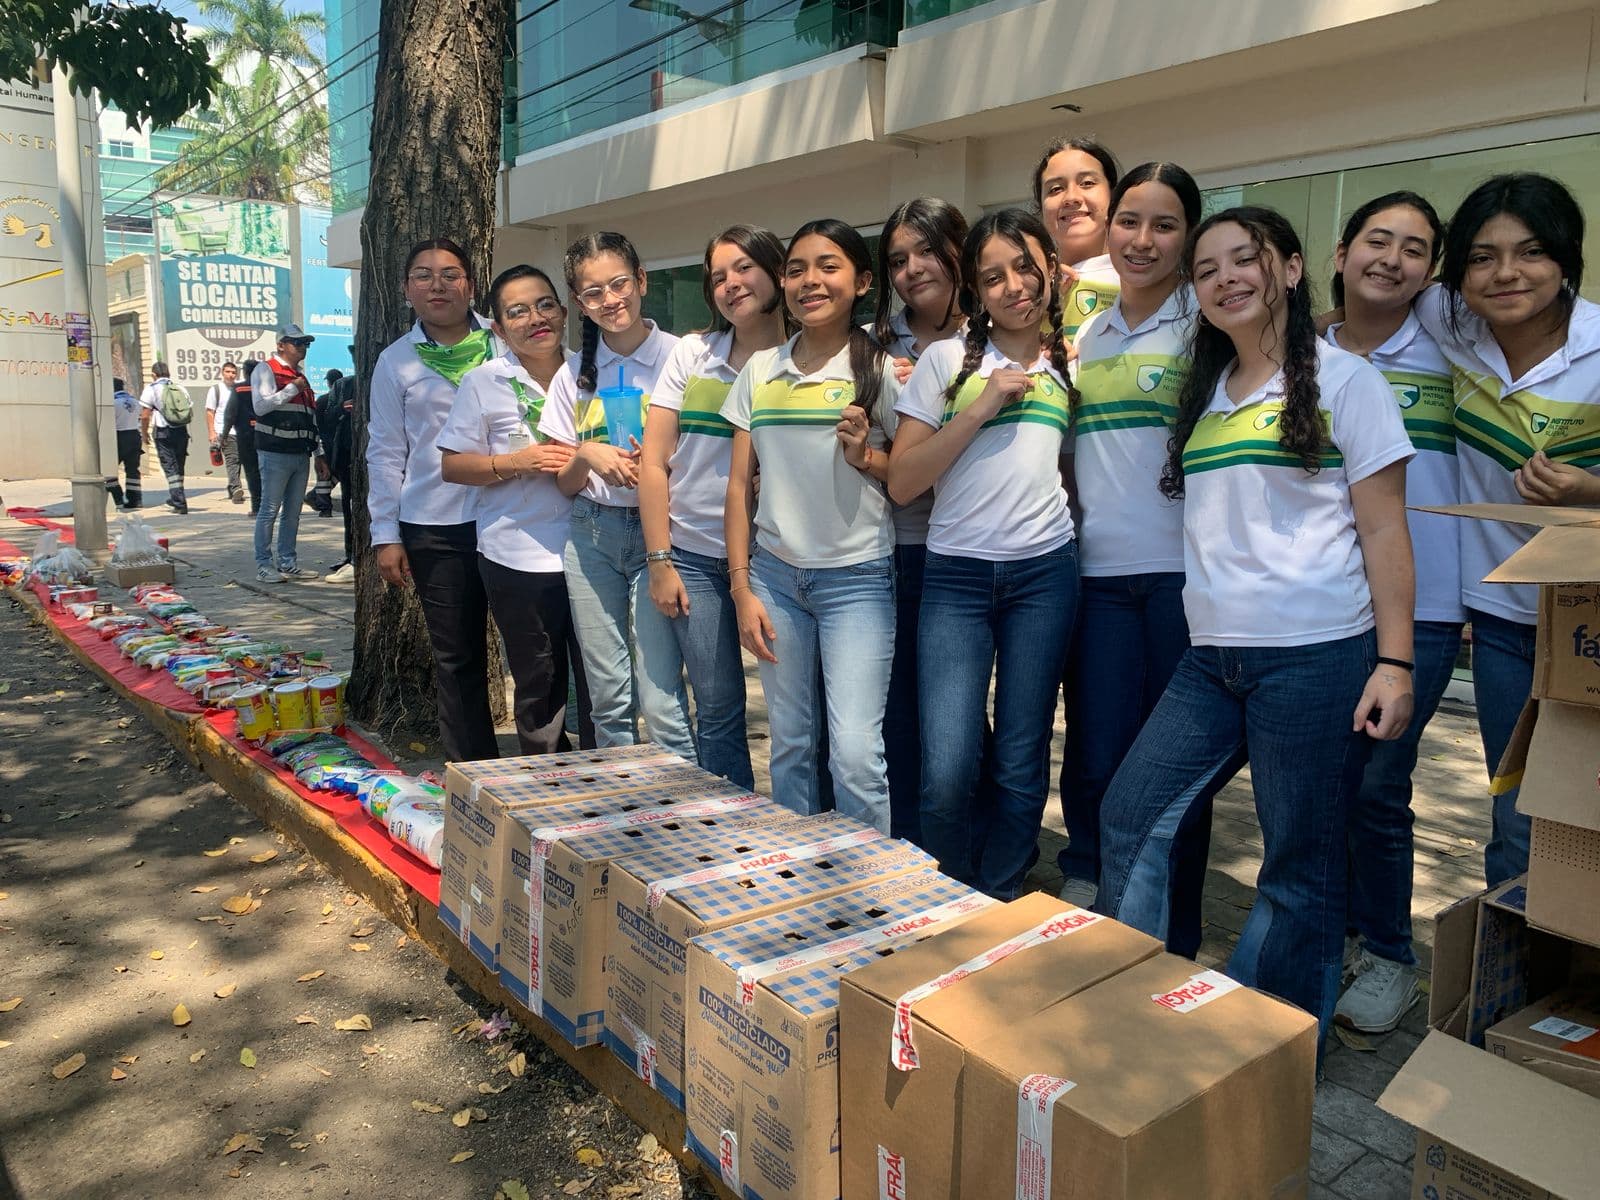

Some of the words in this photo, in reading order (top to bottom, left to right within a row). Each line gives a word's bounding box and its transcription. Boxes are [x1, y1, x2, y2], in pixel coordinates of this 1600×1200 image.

[178, 261, 201, 281] SE
[206, 263, 276, 285] RENTAN
[180, 283, 278, 309] LOCALES
[181, 308, 278, 326] COMERCIALES
[205, 329, 259, 340] INFORMES
[176, 349, 197, 364] 99
[201, 350, 220, 364] 33
[225, 350, 243, 365] 52
[177, 366, 198, 381] 99
[202, 366, 222, 381] 32
[702, 990, 726, 1019] 100%
[727, 1009, 787, 1061] RECICLADO
